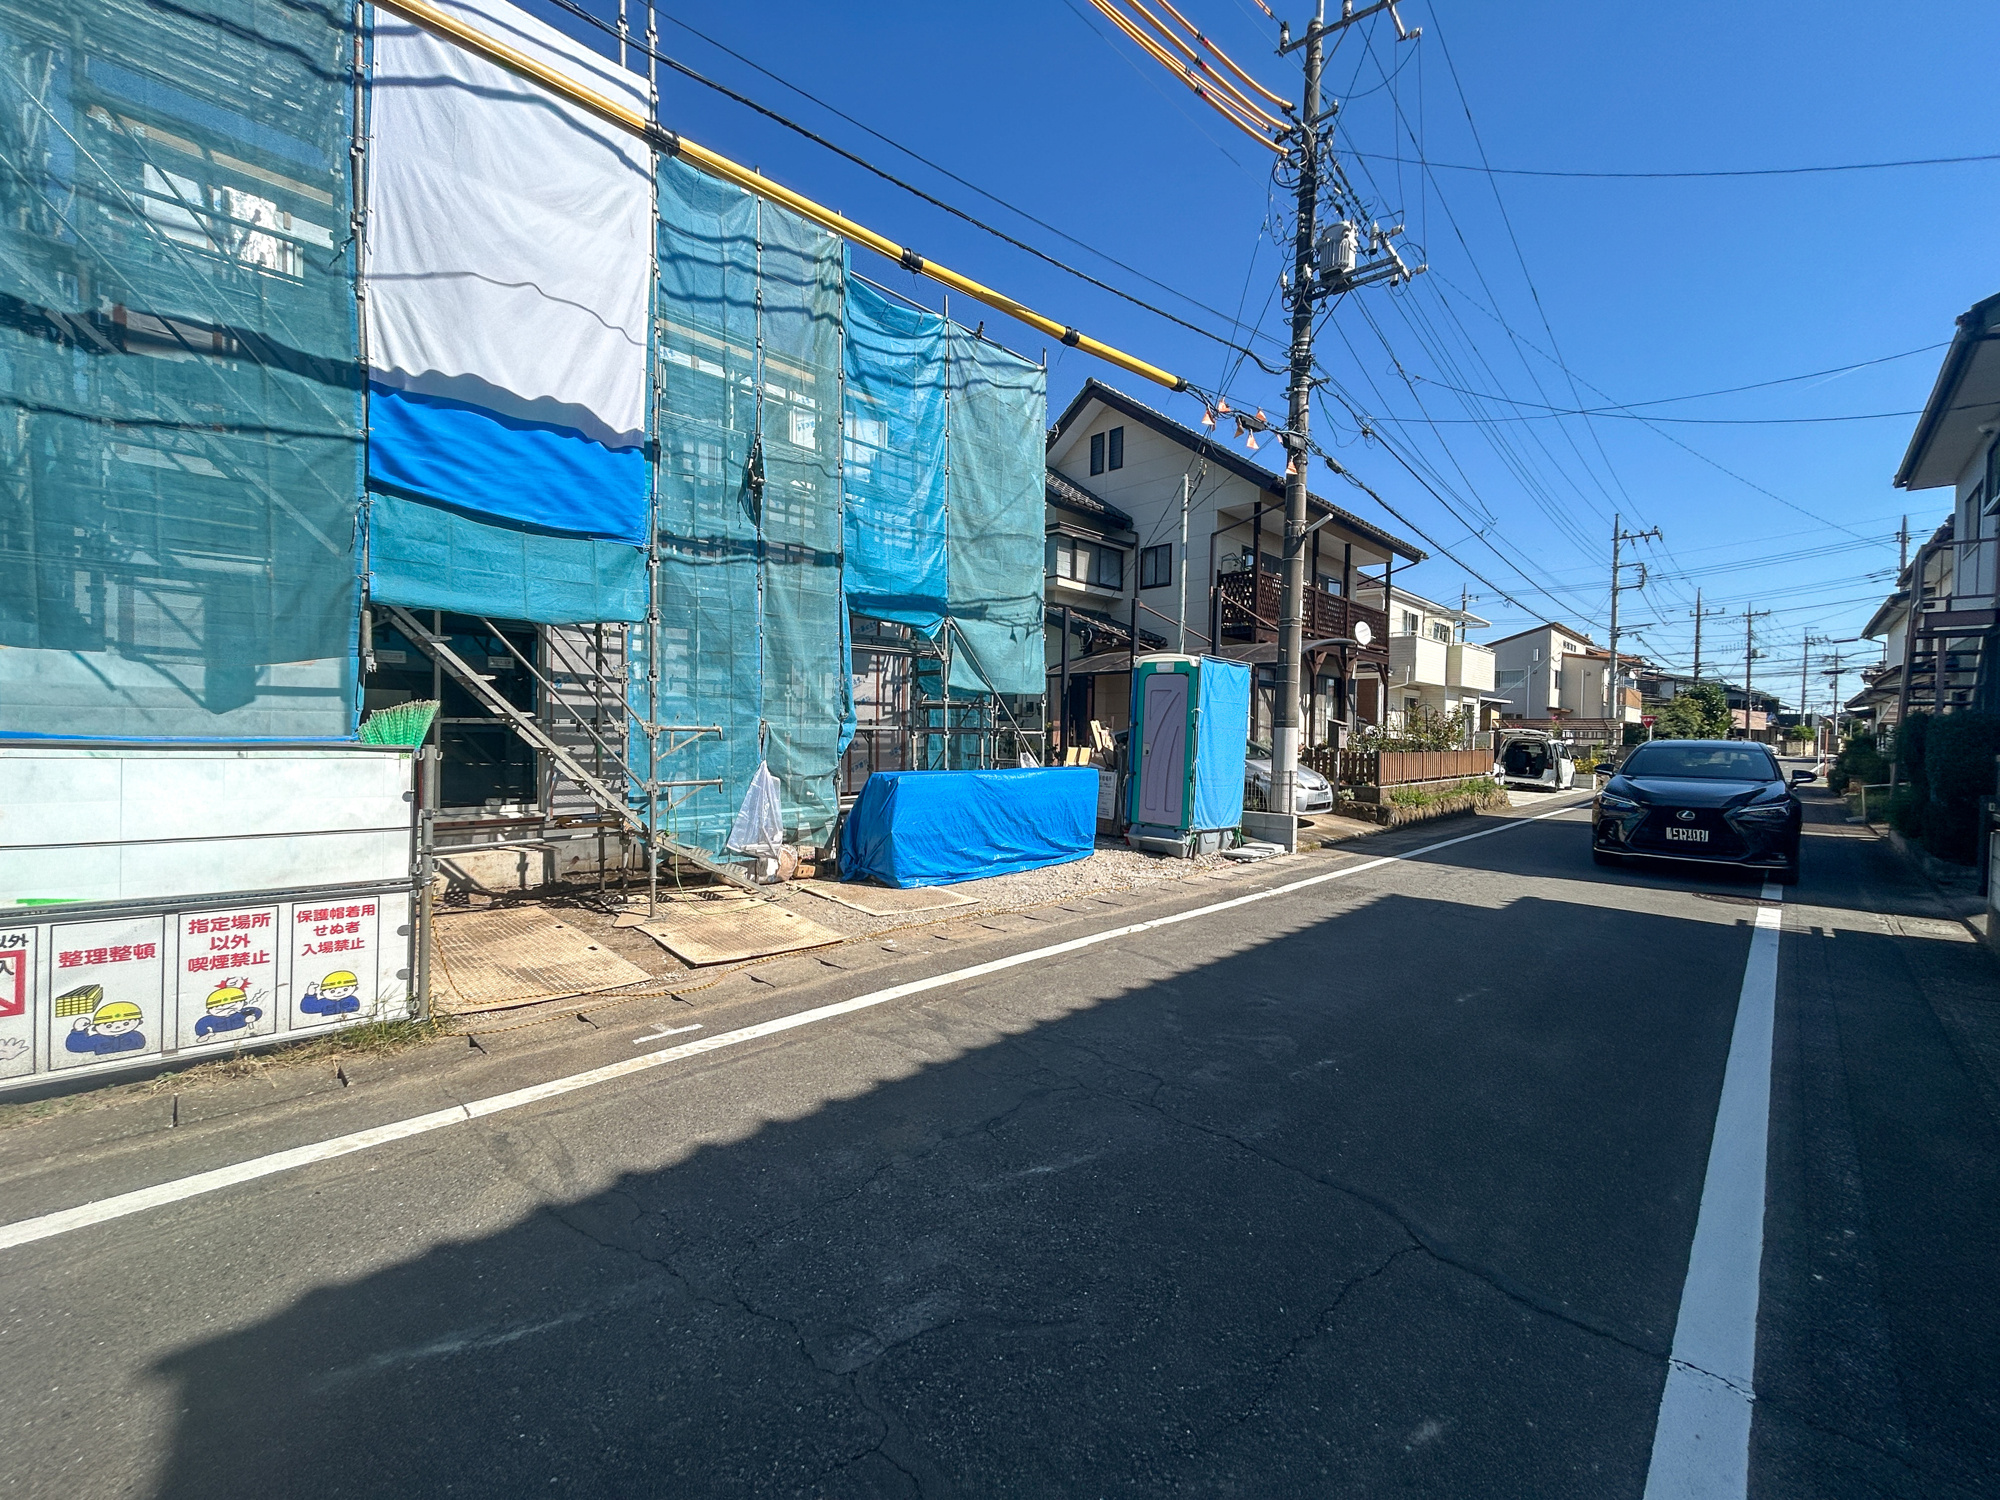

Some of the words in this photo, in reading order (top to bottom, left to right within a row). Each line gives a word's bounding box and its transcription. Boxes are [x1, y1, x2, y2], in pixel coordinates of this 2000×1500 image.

[188, 912, 271, 935] 指定場所
[296, 904, 376, 924] 保護帽着用
[313, 921, 361, 937] せぬ者
[209, 934, 251, 951] 以外
[301, 937, 365, 957] 入場禁止
[58, 943, 156, 968] 整理整頓
[188, 950, 270, 973] 喫煙禁止
